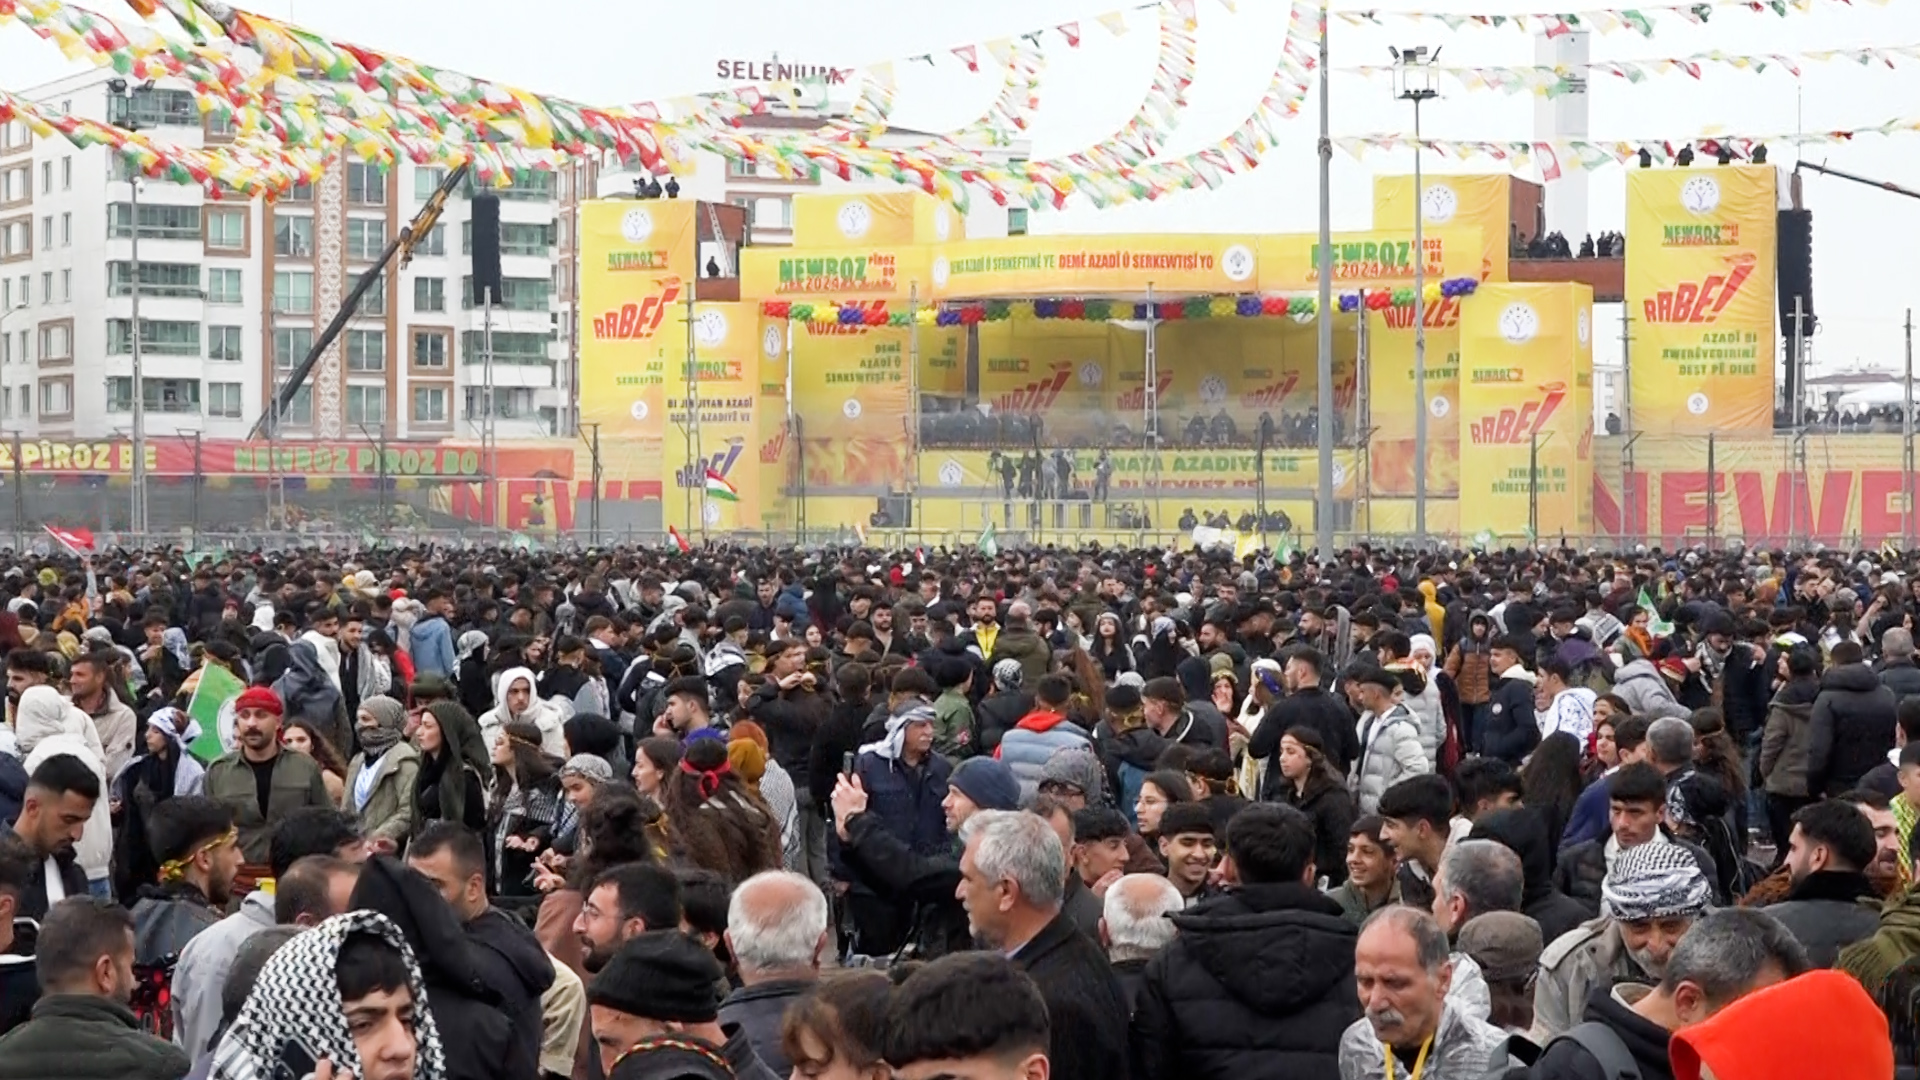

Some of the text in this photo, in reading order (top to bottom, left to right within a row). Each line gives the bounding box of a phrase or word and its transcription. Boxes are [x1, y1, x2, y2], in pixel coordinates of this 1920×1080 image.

[1411, 238, 1442, 250] PROZ
[779, 256, 867, 282] NEWROZ
[1088, 250, 1120, 269] AZADÎ
[1199, 254, 1213, 269] YO
[1643, 265, 1755, 323] RABE!
[681, 361, 727, 376] NWROZ
[1470, 391, 1566, 444] RABE!
[20, 439, 112, 470] PÎROZ
[233, 445, 351, 473] NEWROZ
[443, 449, 479, 475] BO
